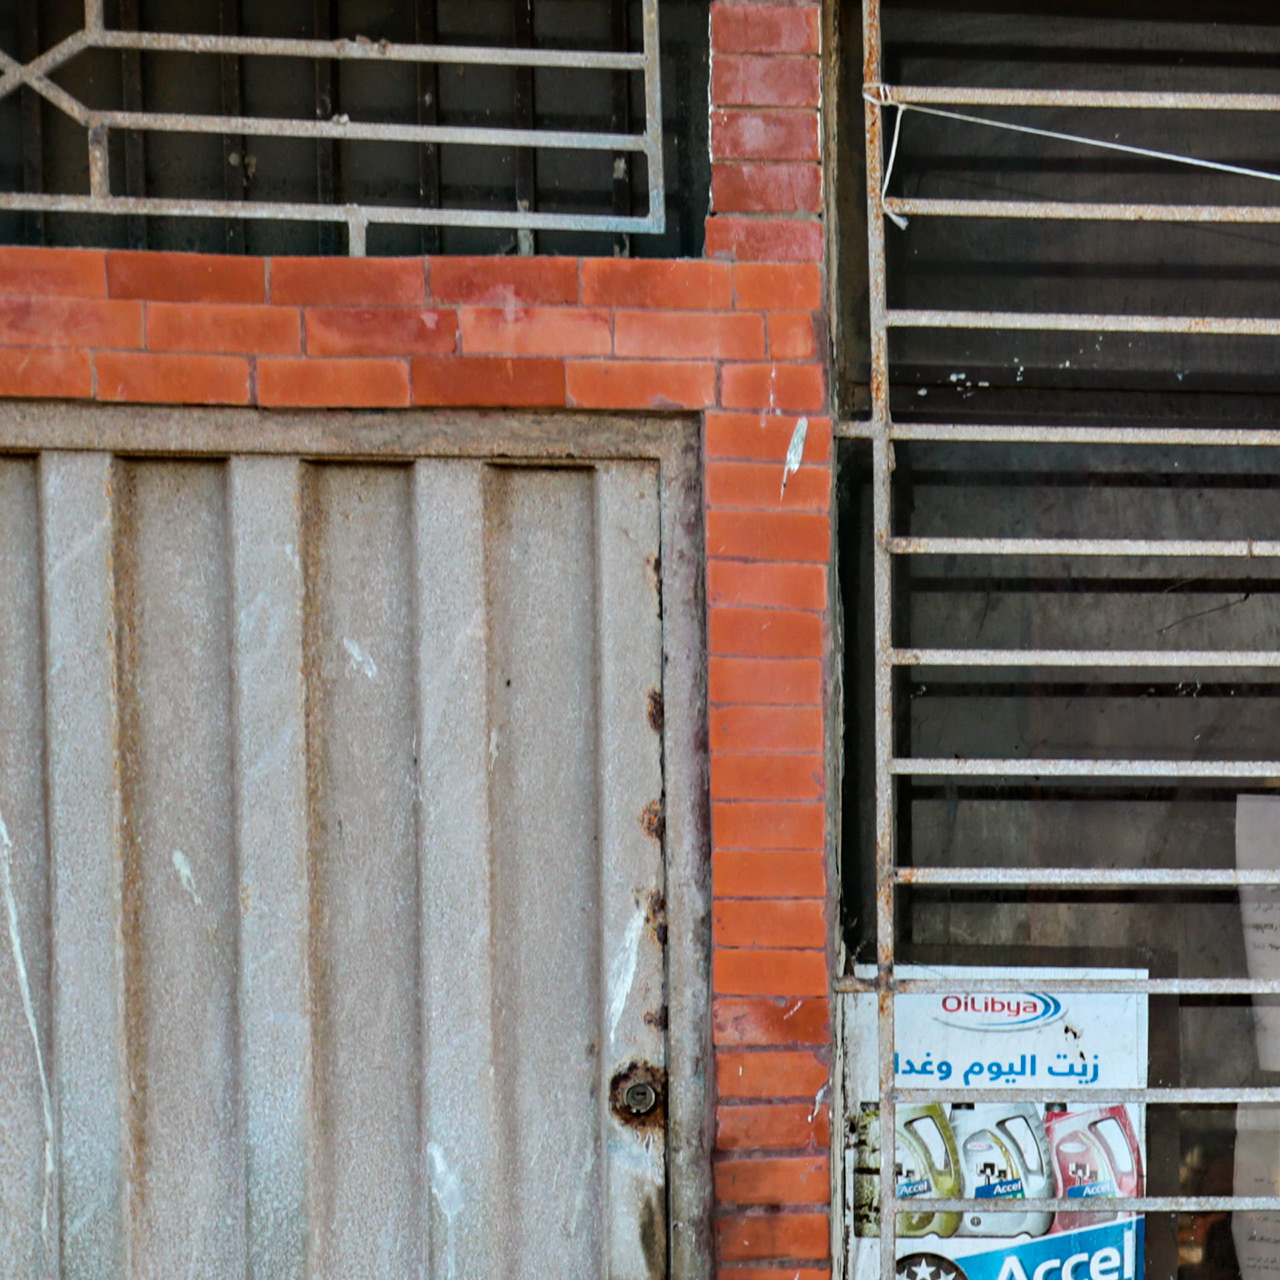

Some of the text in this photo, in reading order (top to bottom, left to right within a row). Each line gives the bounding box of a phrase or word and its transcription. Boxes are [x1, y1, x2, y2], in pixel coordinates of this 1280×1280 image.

[942, 994, 1037, 1017] OiLibya
[894, 1051, 1099, 1086] زيت اليوم وغدا
[900, 1181, 928, 1196] Accel
[993, 1180, 1022, 1194] Accel
[1083, 1182, 1112, 1196] Accel
